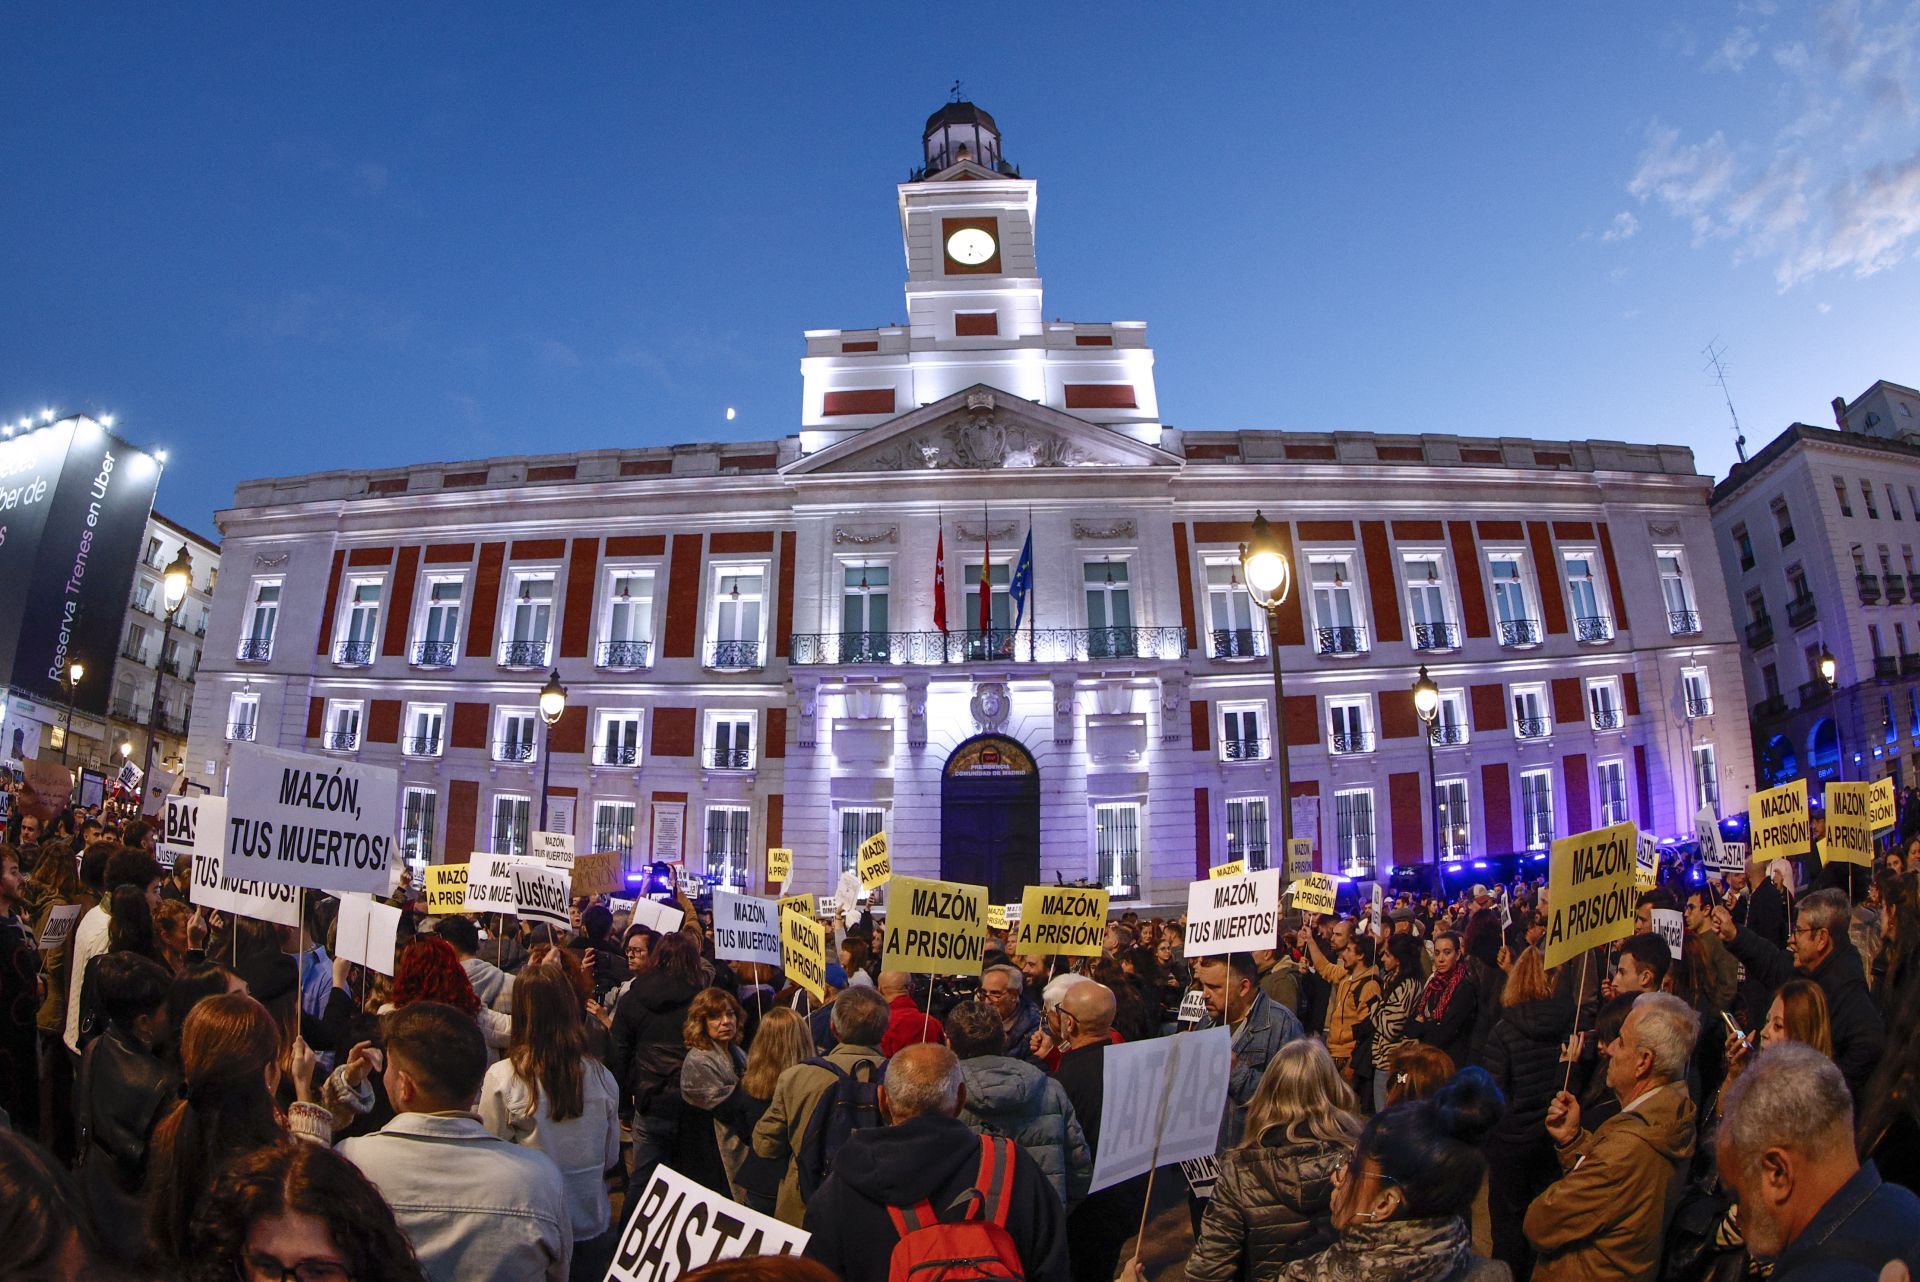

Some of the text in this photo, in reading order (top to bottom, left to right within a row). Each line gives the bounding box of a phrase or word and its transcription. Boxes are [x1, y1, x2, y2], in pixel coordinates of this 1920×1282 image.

[24, 476, 47, 505] de
[48, 451, 115, 682] Reserva Trenes en Uber
[279, 767, 361, 821] MAZÓN,
[1761, 788, 1803, 819] MAZÓN,
[1834, 787, 1867, 821] MAZÓN,
[231, 817, 390, 871] TUS MUERTOS!
[1753, 818, 1810, 850] A PRISIÓN!
[1827, 823, 1871, 854] A PRISIÓN!
[1572, 833, 1631, 886] MAZÓN,
[1719, 845, 1744, 865] ASTA!
[194, 855, 219, 889] TUS
[437, 866, 468, 884] MAZÓ
[860, 870, 868, 883] A
[1217, 865, 1241, 877] MAZÓN,
[1304, 876, 1334, 893] MAZÓN,
[429, 891, 465, 905] A PRISI
[469, 884, 513, 902] TUS MUE
[516, 871, 569, 915] Justicia!
[912, 889, 980, 927] MAZÓN,
[1041, 893, 1100, 920] MAZÓN,
[1214, 878, 1258, 909] MAZÓN,
[1295, 891, 1334, 909] A PRISIÓN!
[734, 901, 768, 927] MAZÓN,
[1189, 912, 1275, 944] TUS MUERTOS!
[1549, 909, 1563, 946] A
[1567, 883, 1635, 940] PRISIÓN!
[717, 928, 778, 952] TUS MUERTOS!
[791, 920, 822, 959] MAZÓN,
[886, 928, 985, 961] A PRISIÓN!
[1020, 922, 1104, 946] A PRISIÓN!
[786, 946, 793, 965] A
[617, 1177, 794, 1282] BAST
